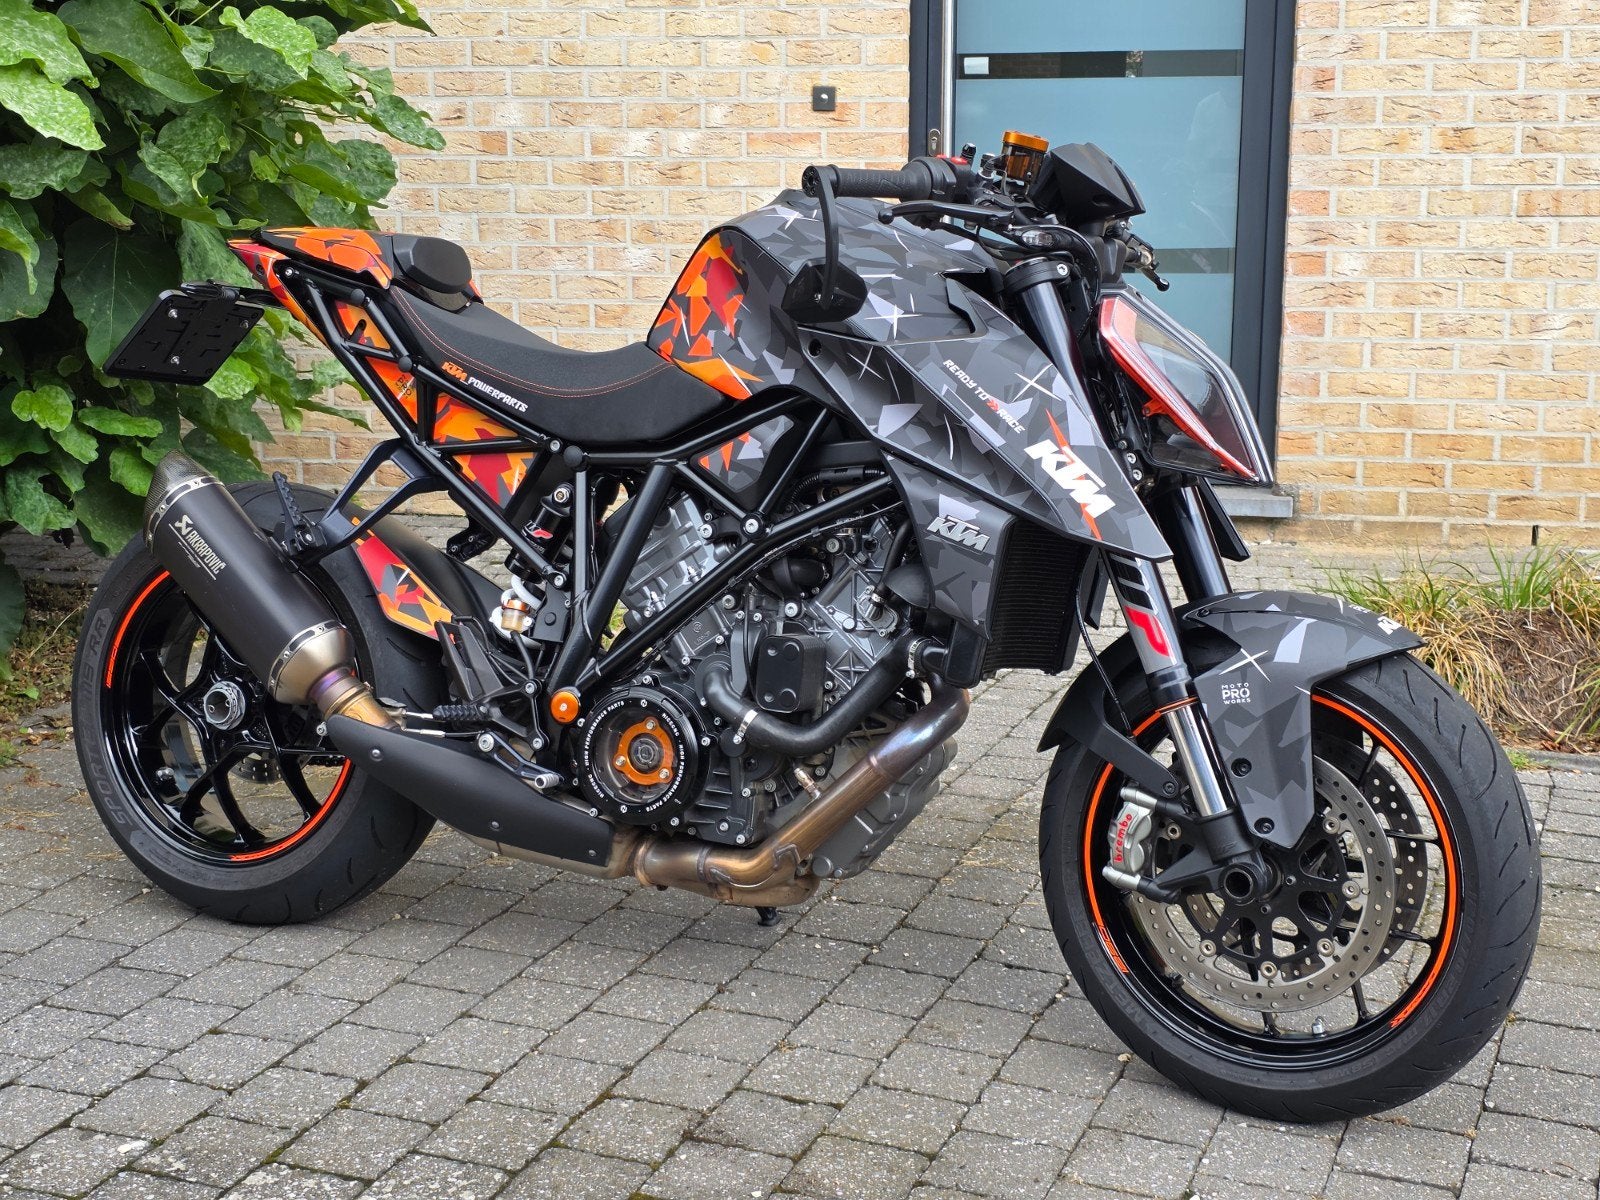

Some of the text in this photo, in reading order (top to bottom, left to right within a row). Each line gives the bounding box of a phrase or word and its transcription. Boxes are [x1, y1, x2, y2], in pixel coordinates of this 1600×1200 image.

[441, 361, 468, 381] KTM
[943, 359, 1026, 434] READY TO RACE
[1023, 439, 1116, 518] KTM
[926, 515, 991, 552] KTM
[1221, 682, 1250, 690] MOTO
[1222, 688, 1251, 700] PRO
[585, 710, 608, 749] PERFORMANCE
[607, 700, 625, 712] PARTS
[662, 761, 685, 803] PERFORMANCE
[645, 801, 663, 812] PARTS
[1113, 814, 1132, 862] brembo
